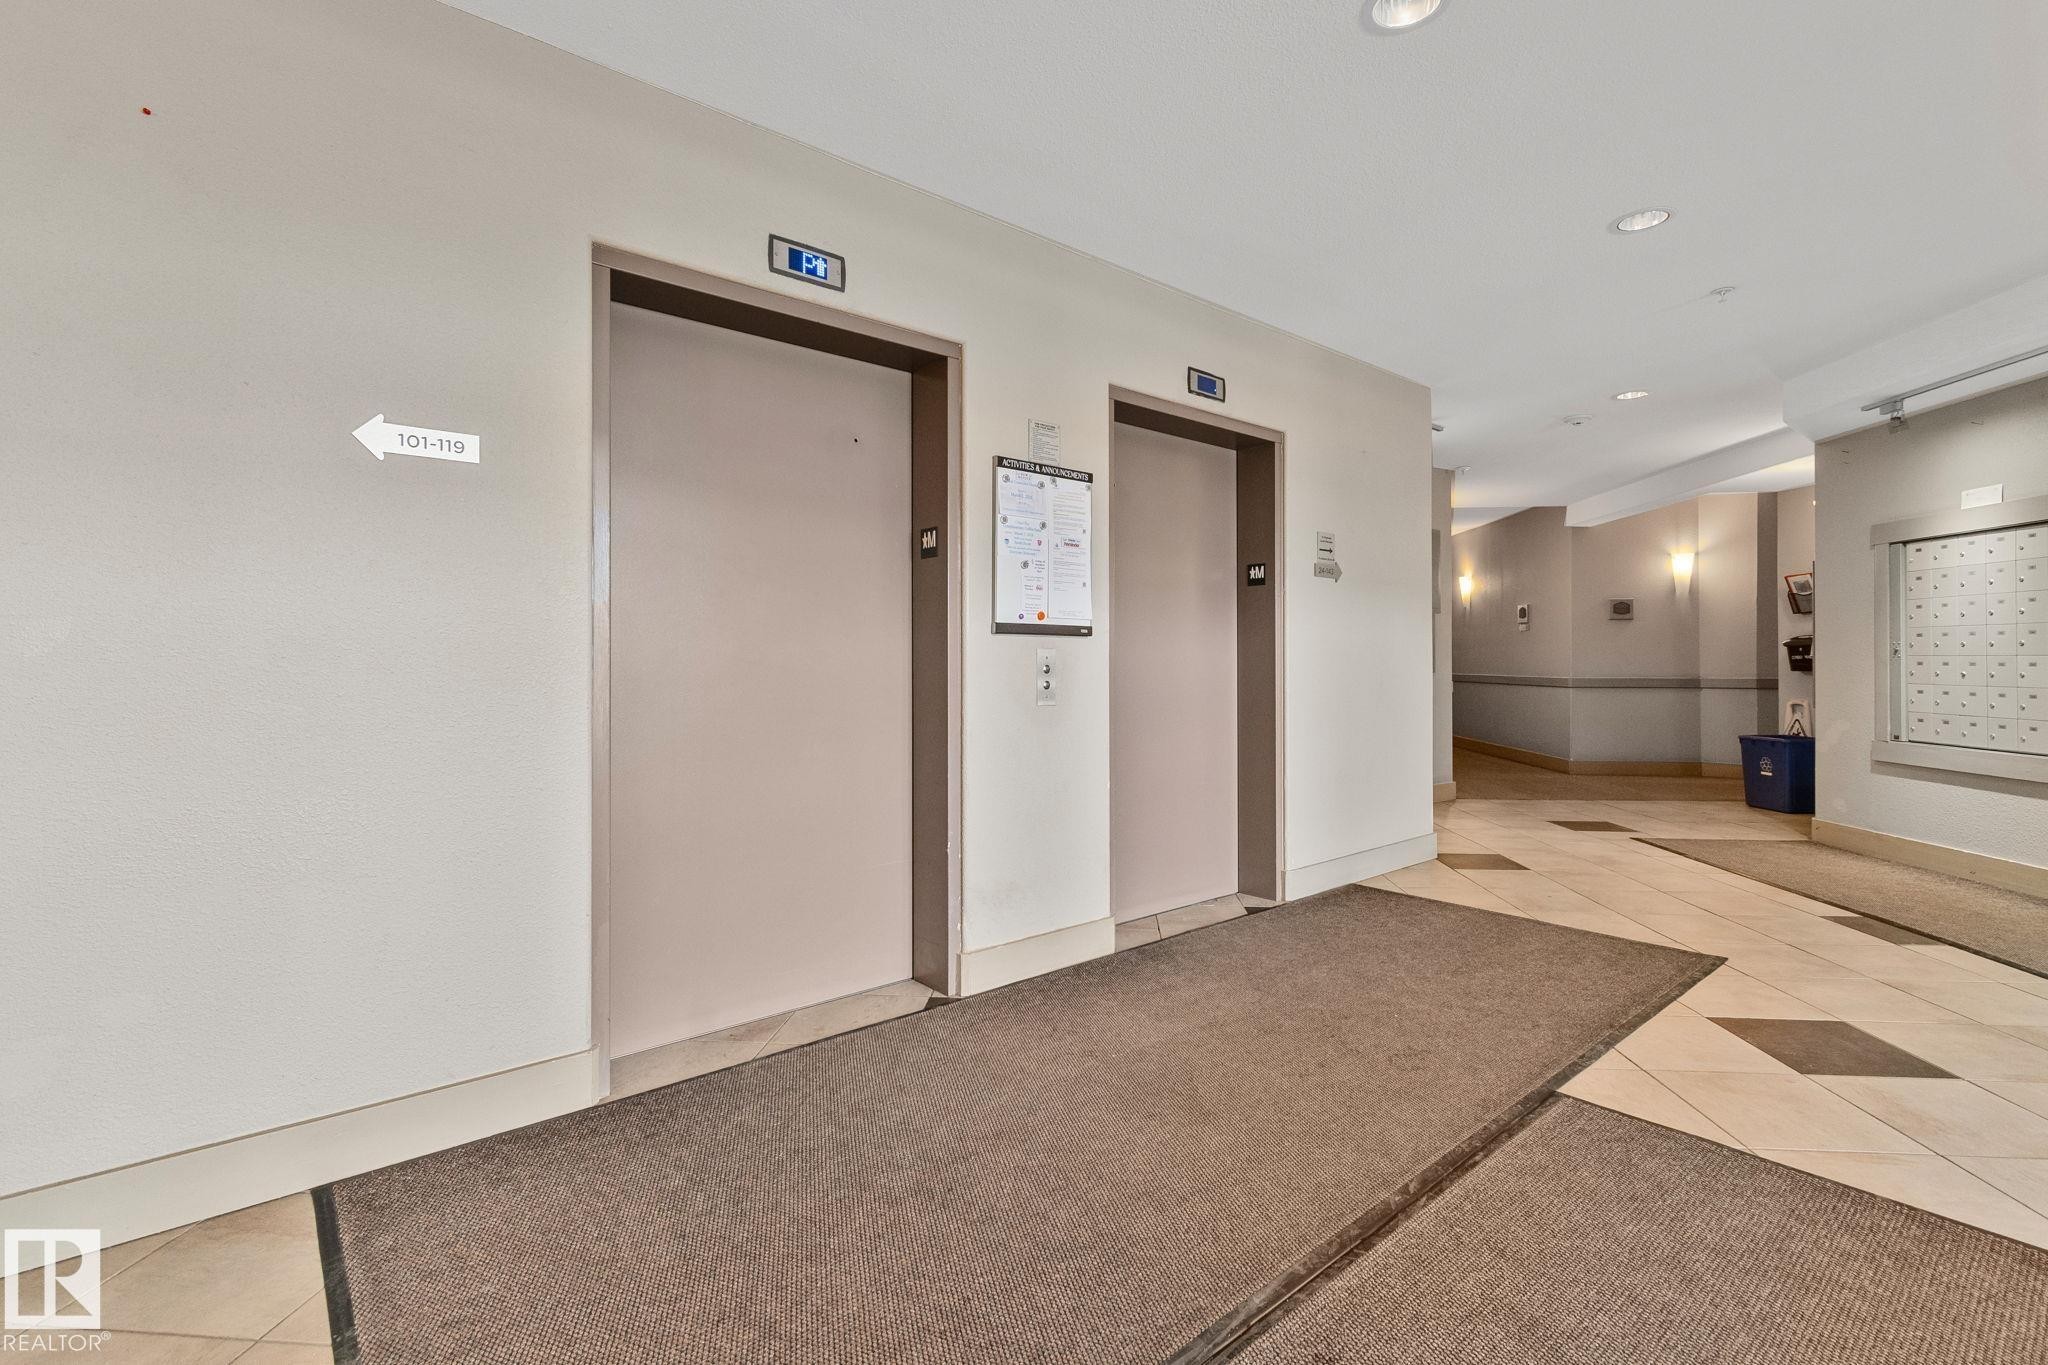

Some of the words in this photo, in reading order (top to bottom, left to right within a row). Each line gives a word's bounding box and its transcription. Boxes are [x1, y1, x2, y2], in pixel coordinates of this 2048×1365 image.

[397, 433, 465, 454] 101-119
[1002, 458, 1035, 472] ACTIVITIES
[1041, 465, 1089, 481] ANNOUNCEMENTS
